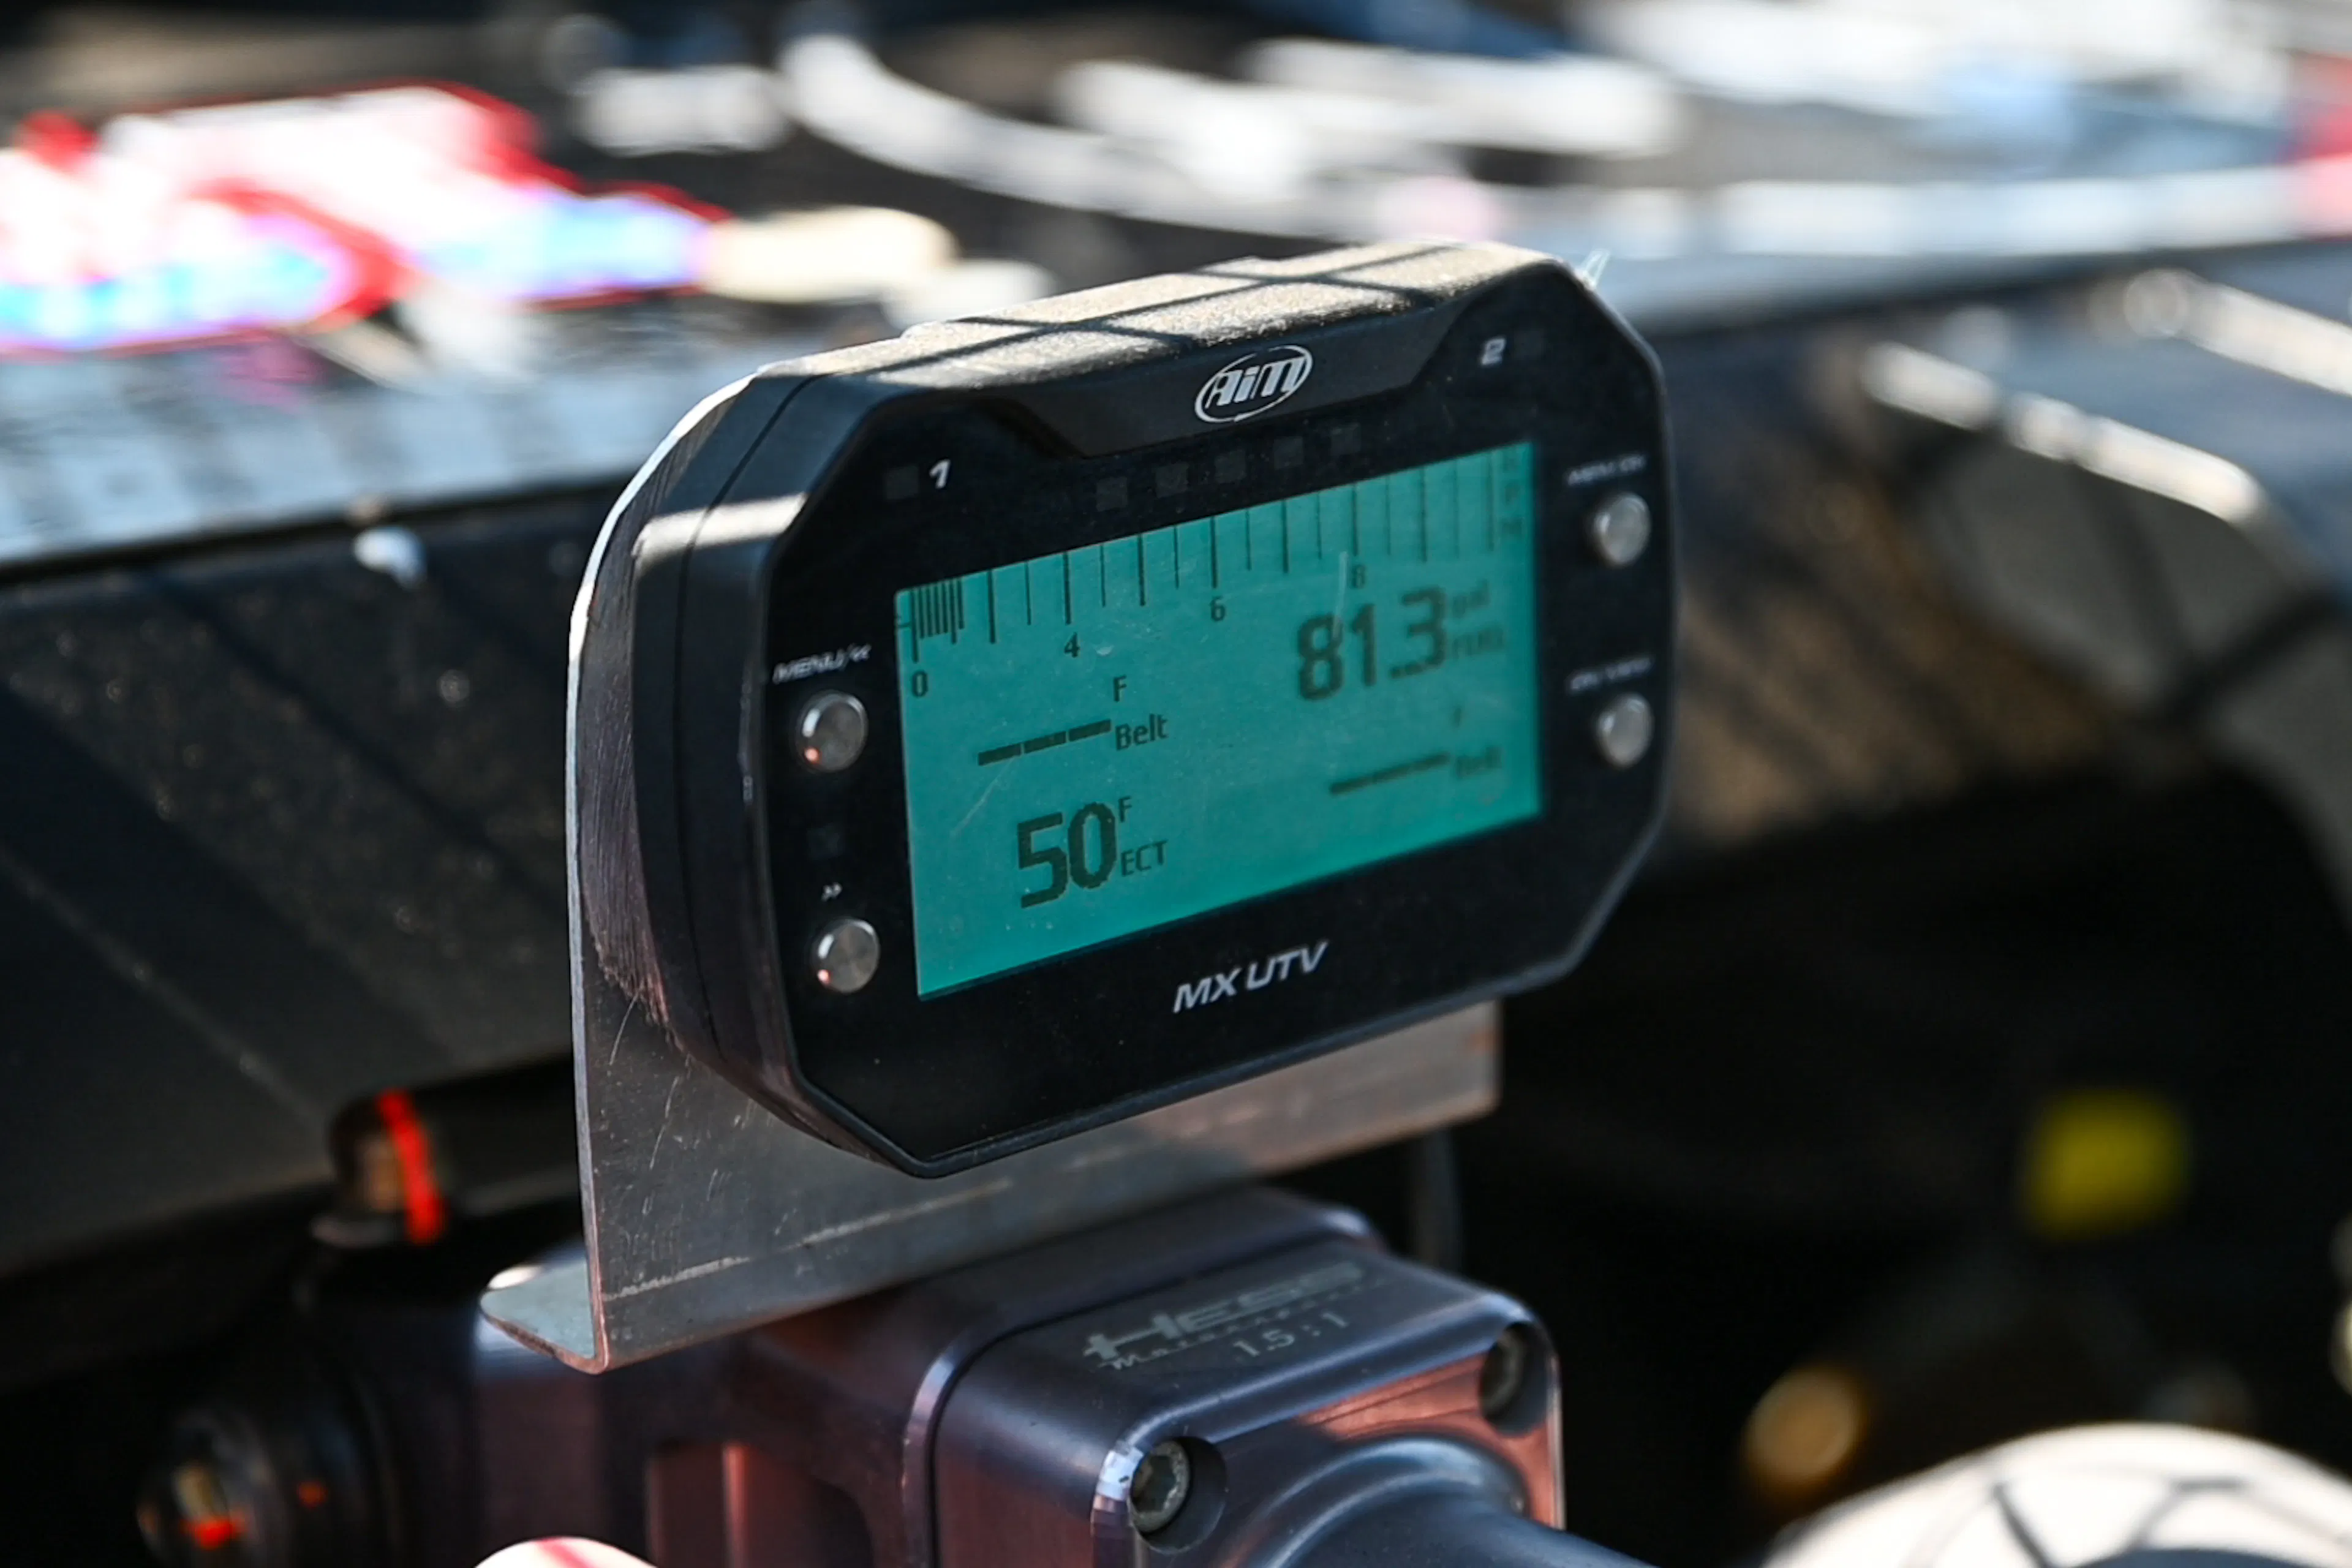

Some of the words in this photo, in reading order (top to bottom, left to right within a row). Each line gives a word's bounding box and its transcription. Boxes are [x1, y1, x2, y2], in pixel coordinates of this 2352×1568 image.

[929, 459, 951, 489] 1
[1210, 598, 1226, 622] 6
[1063, 631, 1081, 658] 4
[1297, 586, 1449, 702] 81.3
[911, 671, 928, 698] 0
[1113, 674, 1128, 703] F
[1115, 712, 1169, 751] Belt
[1118, 796, 1133, 823] F
[1017, 802, 1118, 910] 50
[1120, 839, 1169, 877] ECT
[1172, 967, 1242, 1013] MX
[1244, 940, 1329, 992] UTV
